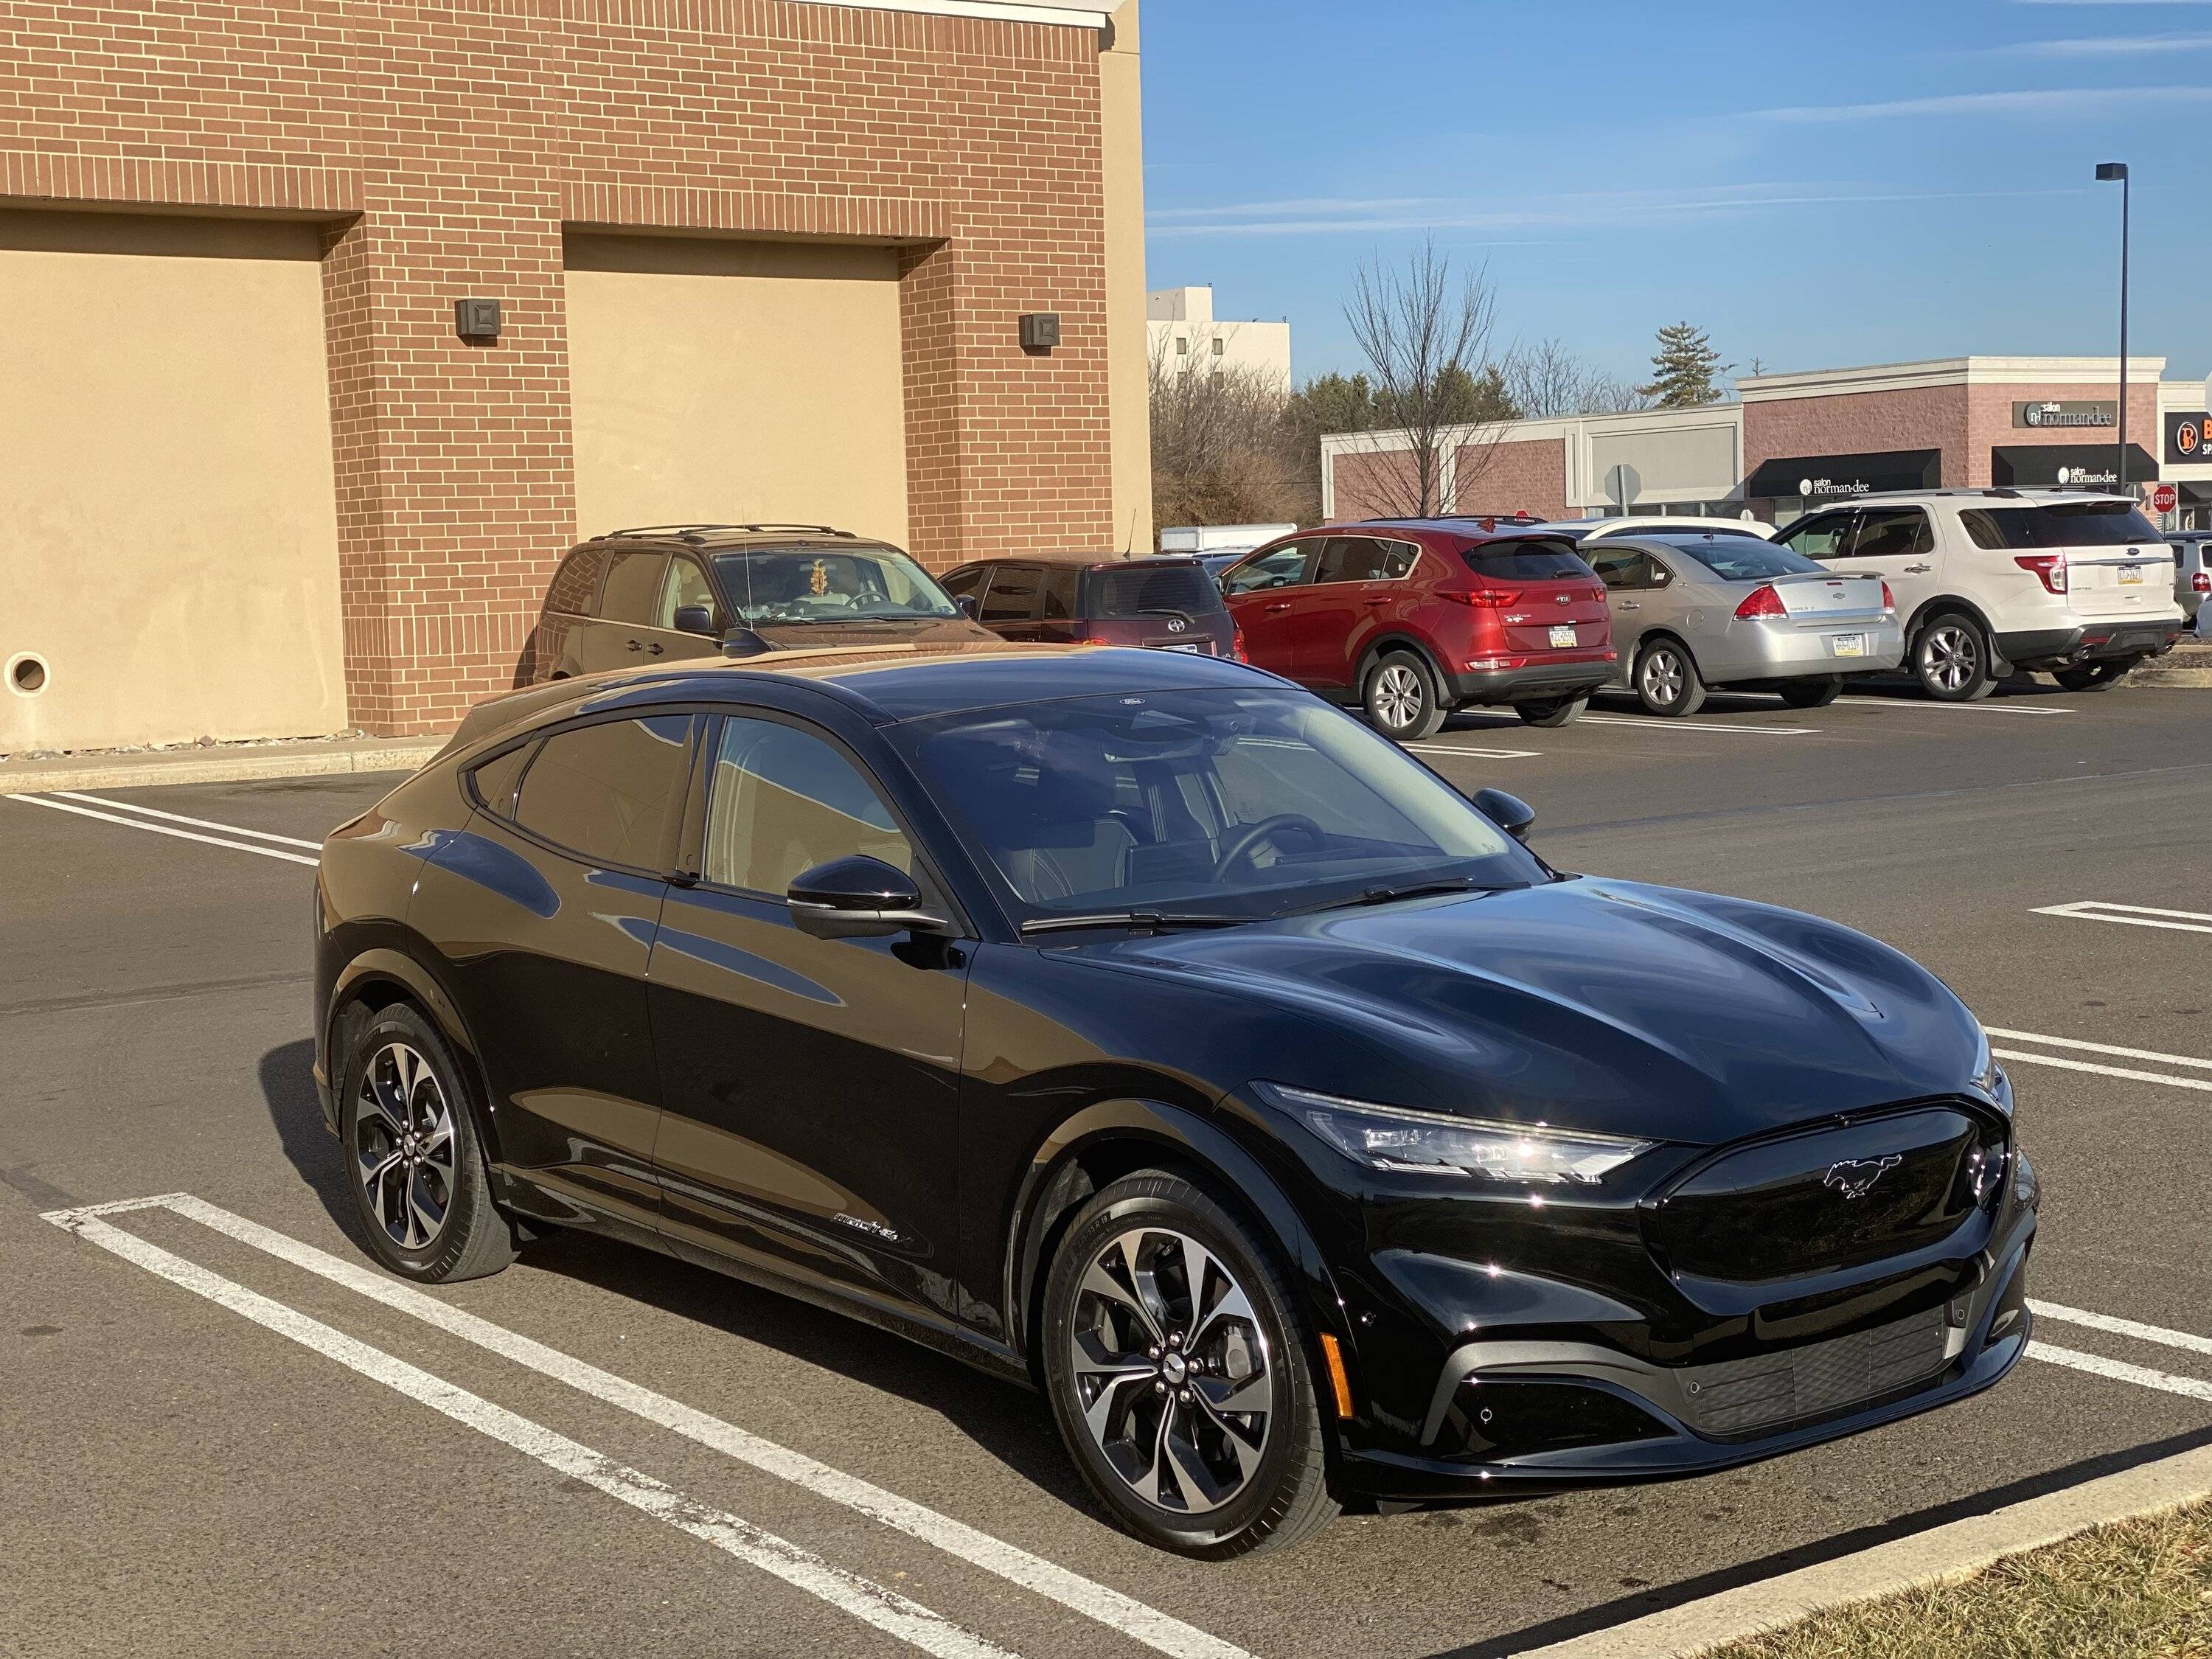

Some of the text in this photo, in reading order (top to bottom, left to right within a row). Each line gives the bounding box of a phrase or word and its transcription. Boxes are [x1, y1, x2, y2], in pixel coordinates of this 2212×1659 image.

[2042, 402, 2061, 412] salon
[2202, 443, 2212, 455] SP
[2070, 467, 2085, 476] salon
[1814, 478, 1832, 487] salon
[2154, 493, 2175, 505] STOP
